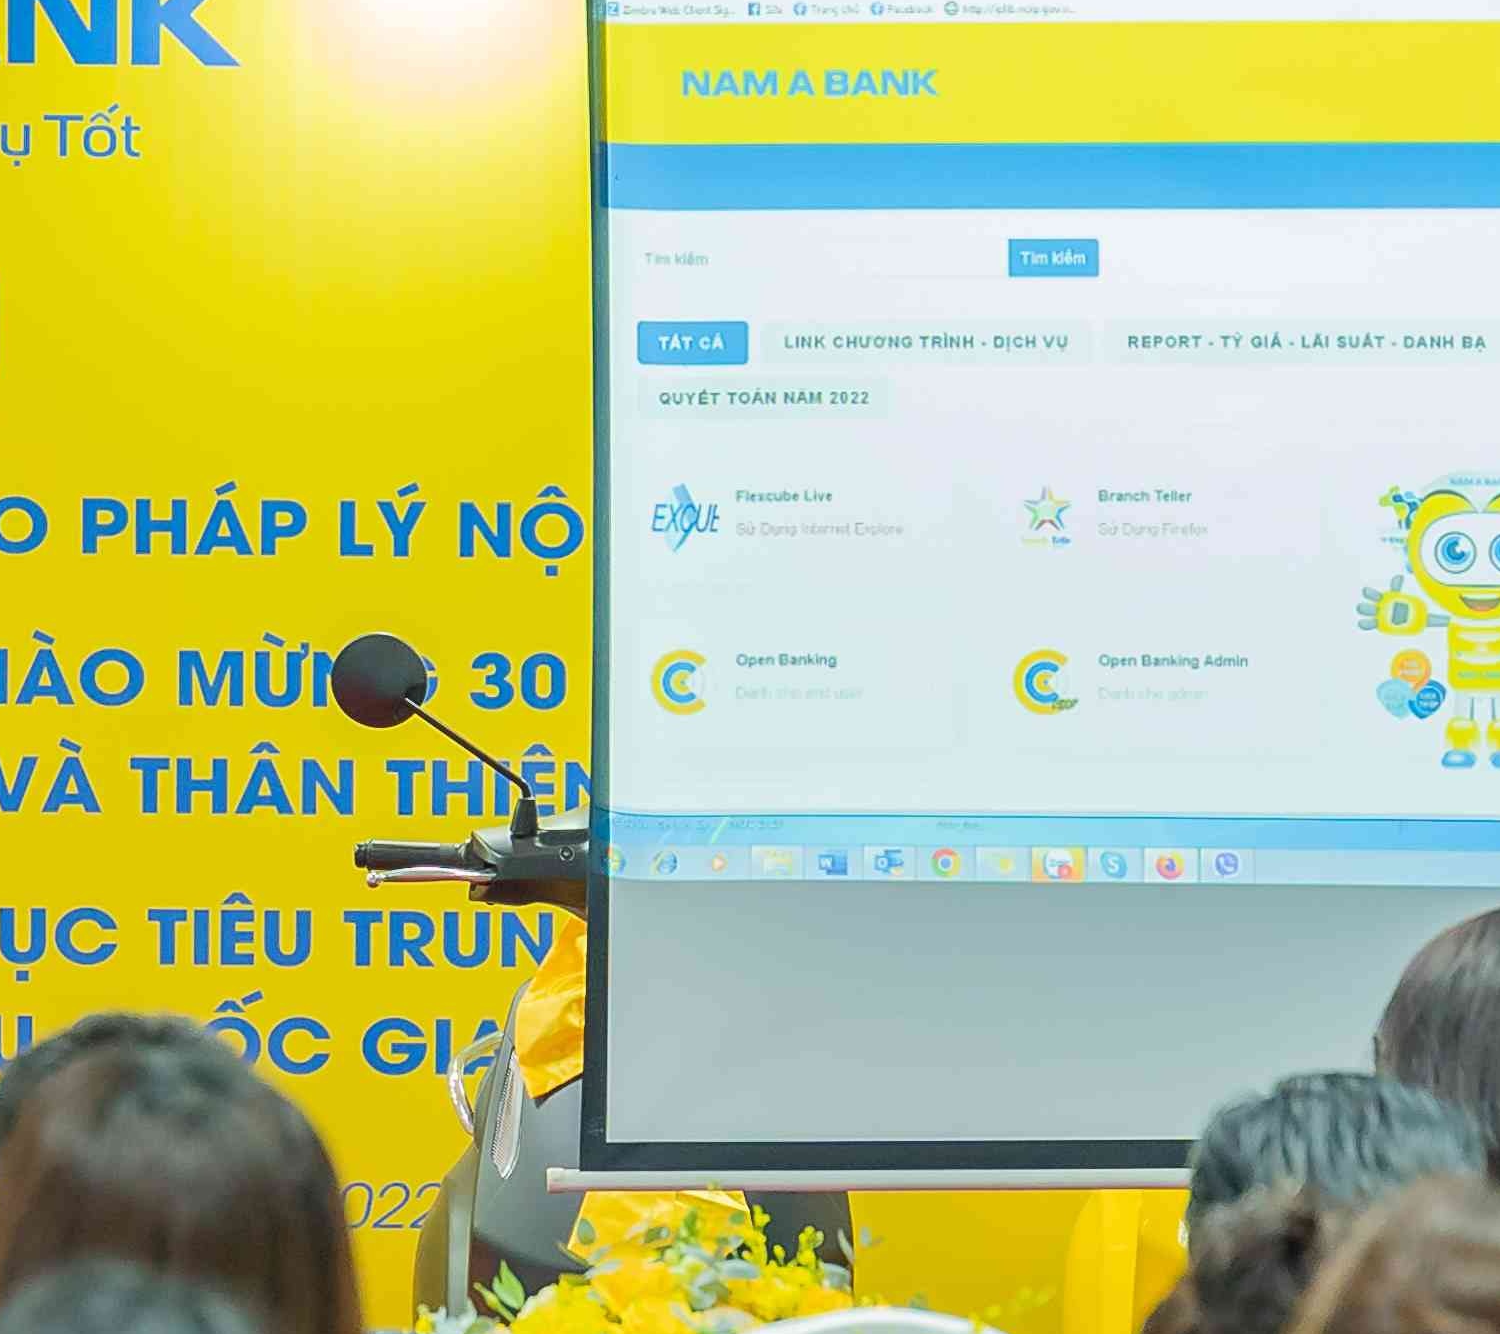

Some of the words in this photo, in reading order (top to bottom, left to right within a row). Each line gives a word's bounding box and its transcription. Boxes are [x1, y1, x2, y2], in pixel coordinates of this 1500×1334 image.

[681, 68, 780, 99] NAM
[786, 69, 817, 98] A
[822, 69, 940, 100] BANK
[44, 114, 139, 158] Tốt
[784, 335, 826, 350] LINK
[1128, 335, 1203, 350] REPORT
[1403, 335, 1455, 350] DANH
[829, 390, 870, 406] 2022
[1098, 489, 1150, 503] Branch
[1155, 489, 1193, 503] Teller
[81, 481, 307, 557] PHÁP
[339, 483, 425, 558] LÝ
[735, 654, 775, 669] Open
[779, 653, 837, 669] Banking
[1098, 654, 1137, 669] Open
[1142, 654, 1200, 669] Banking
[1204, 655, 1249, 668] Admin
[469, 652, 567, 711] 30
[129, 741, 355, 817] THÂN
[146, 891, 313, 968] TIÊU
[342, 909, 553, 969] TRUN
